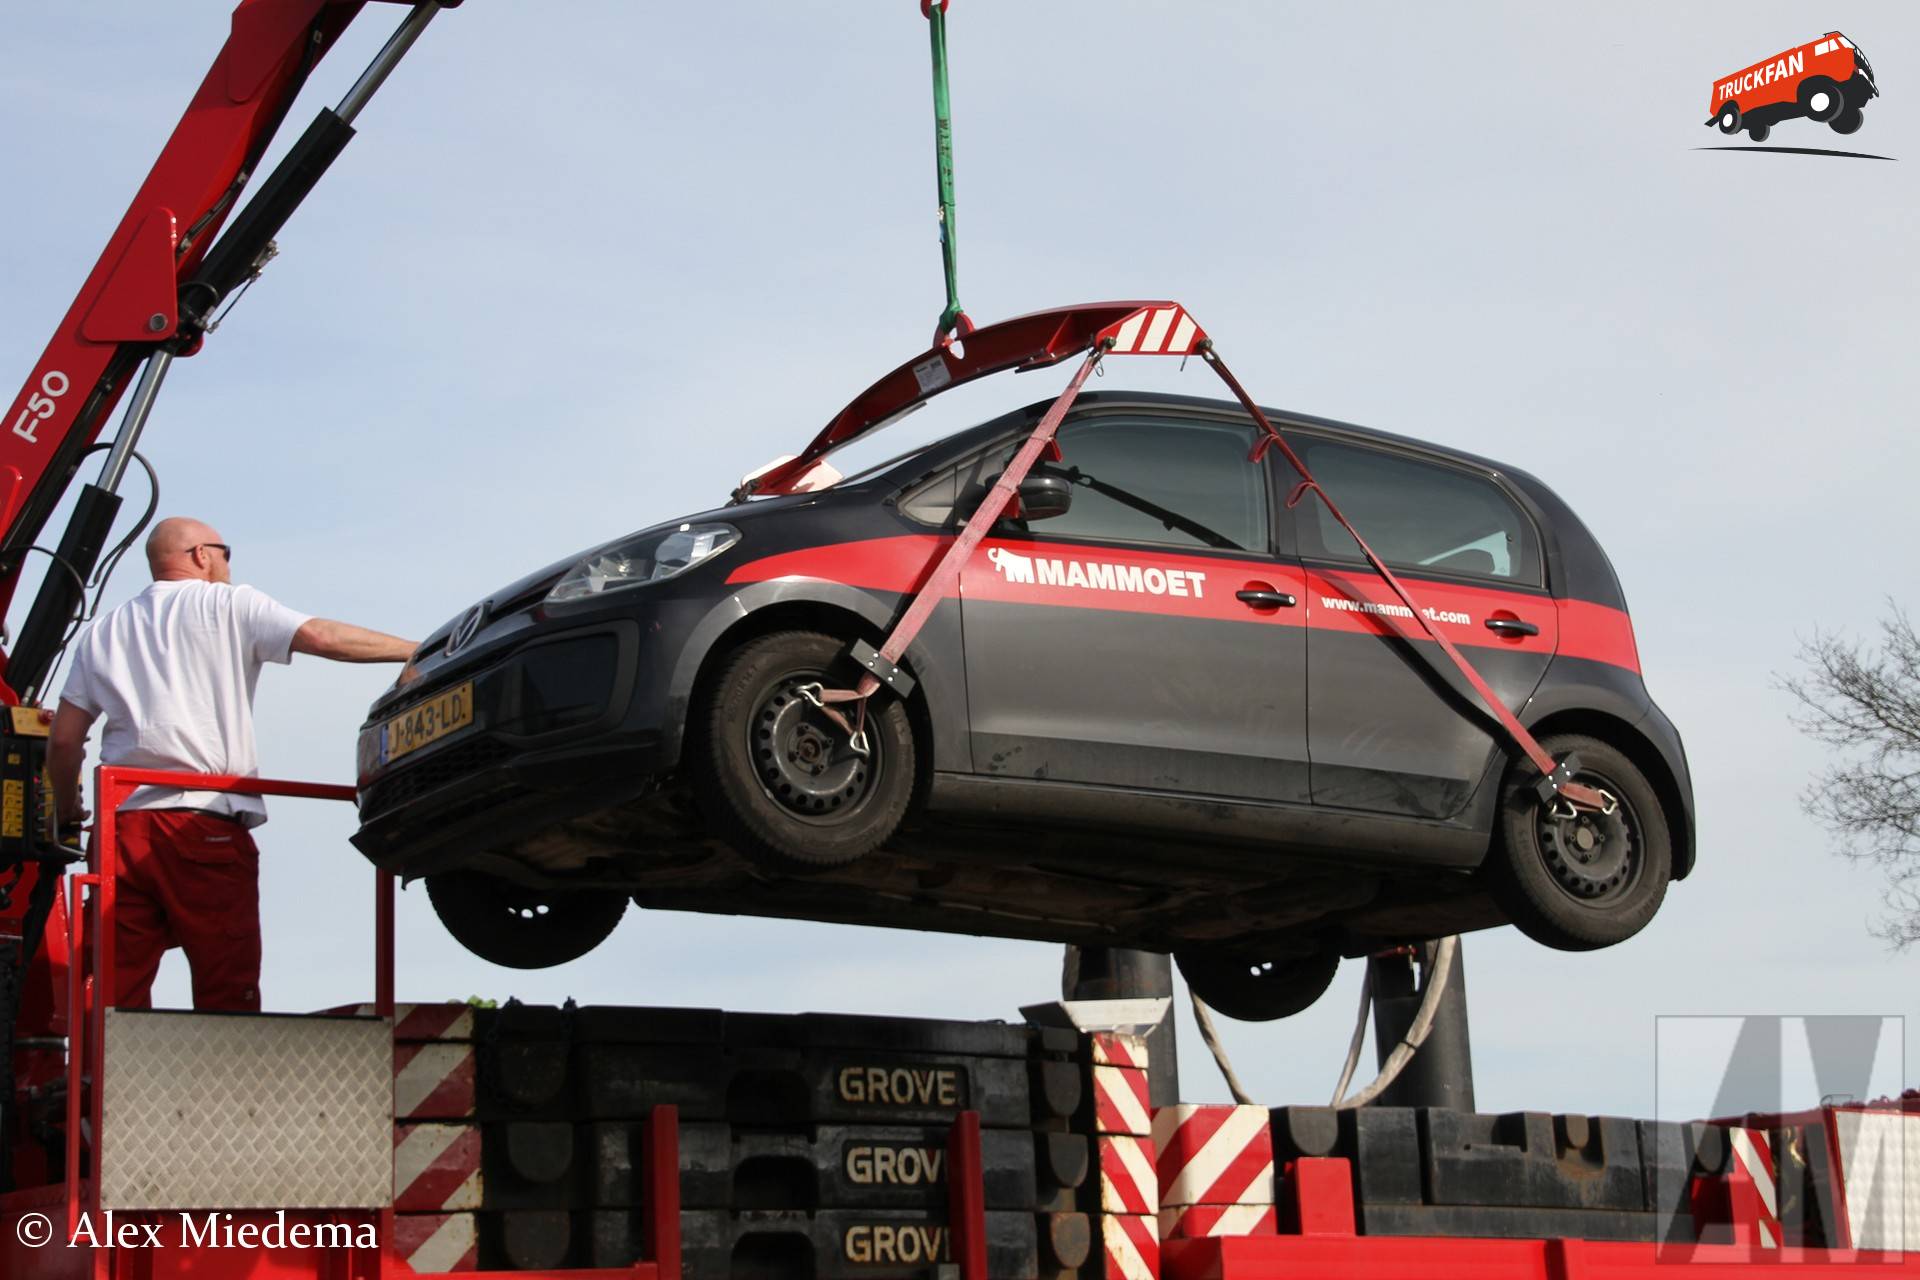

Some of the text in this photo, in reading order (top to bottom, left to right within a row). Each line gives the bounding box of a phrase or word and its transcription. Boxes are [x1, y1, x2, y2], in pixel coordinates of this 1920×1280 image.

[12, 370, 70, 443] F50
[1035, 558, 1206, 598] MAMMOET
[839, 1066, 956, 1106] GROVE
[846, 1146, 948, 1184] GROV
[845, 1226, 949, 1263] GROV
